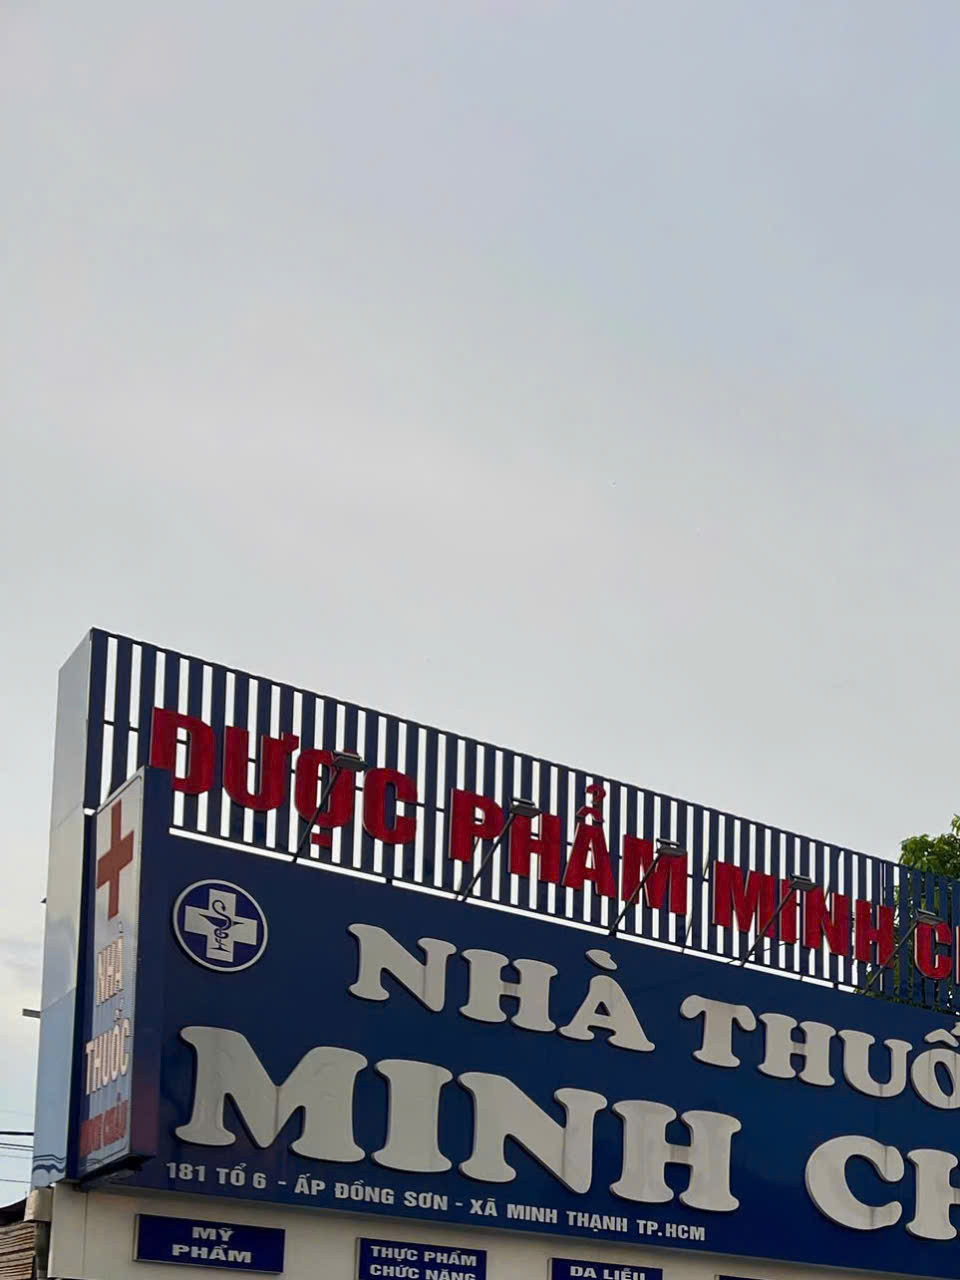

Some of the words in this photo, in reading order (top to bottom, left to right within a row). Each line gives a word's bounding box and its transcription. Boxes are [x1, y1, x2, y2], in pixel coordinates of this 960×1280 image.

[149, 706, 419, 849] DƯỢC
[449, 785, 688, 915] PHẨM
[712, 858, 894, 970] MINH
[347, 921, 656, 1054] NHÀ
[174, 1025, 742, 1213] MINH
[166, 1162, 206, 1182] 181
[216, 1162, 246, 1187] TỔ
[252, 1172, 267, 1190] 6
[294, 1172, 326, 1196] ẤP
[334, 1179, 395, 1205] ĐỒNG
[403, 1190, 448, 1211] SƠN
[469, 1198, 498, 1217] XÃ
[506, 1203, 558, 1224] MINH
[566, 1210, 628, 1233] THẠNH
[192, 1226, 235, 1243] MỸ
[370, 1245, 419, 1262] THỰC
[369, 1263, 420, 1280] CHỨC
[569, 1265, 597, 1280] DA
